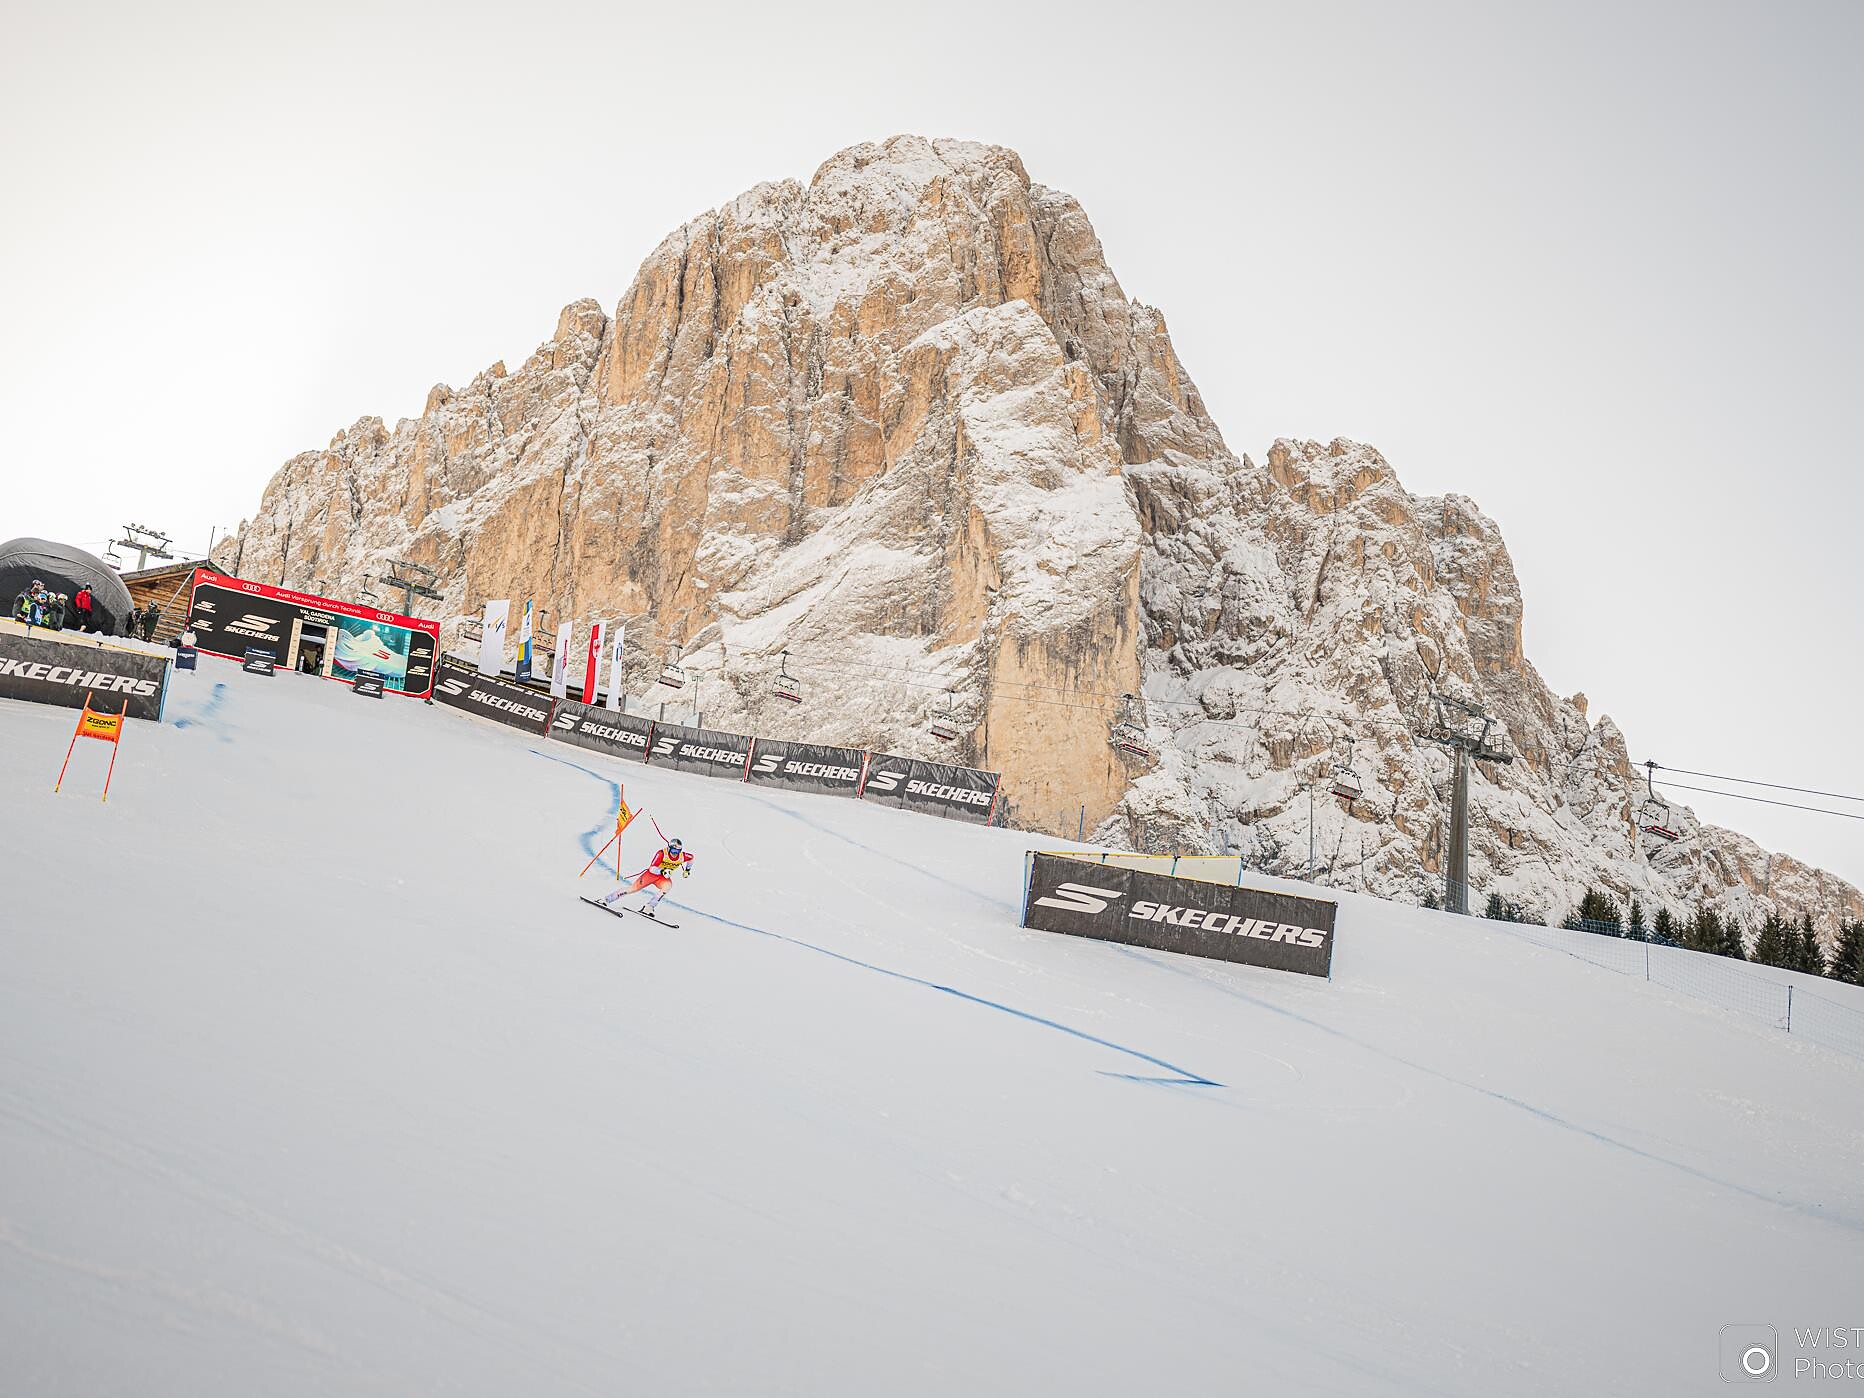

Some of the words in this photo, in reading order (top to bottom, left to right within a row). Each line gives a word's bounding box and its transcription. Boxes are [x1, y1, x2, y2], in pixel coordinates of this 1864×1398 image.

[200, 572, 218, 582] Audi
[276, 591, 291, 599] Audi
[322, 602, 340, 610] durch
[340, 605, 362, 615] Technik
[223, 625, 281, 642] SKECHERS
[417, 622, 435, 630] Audi
[467, 690, 548, 722] SKECHERS
[86, 716, 117, 727] ZGONC
[579, 721, 647, 747] SKECHERS
[678, 744, 747, 765] SKECHERS
[783, 760, 860, 781] SKECHERS
[904, 779, 993, 806] SKECHERS
[1127, 900, 1328, 948] SKECHERS
